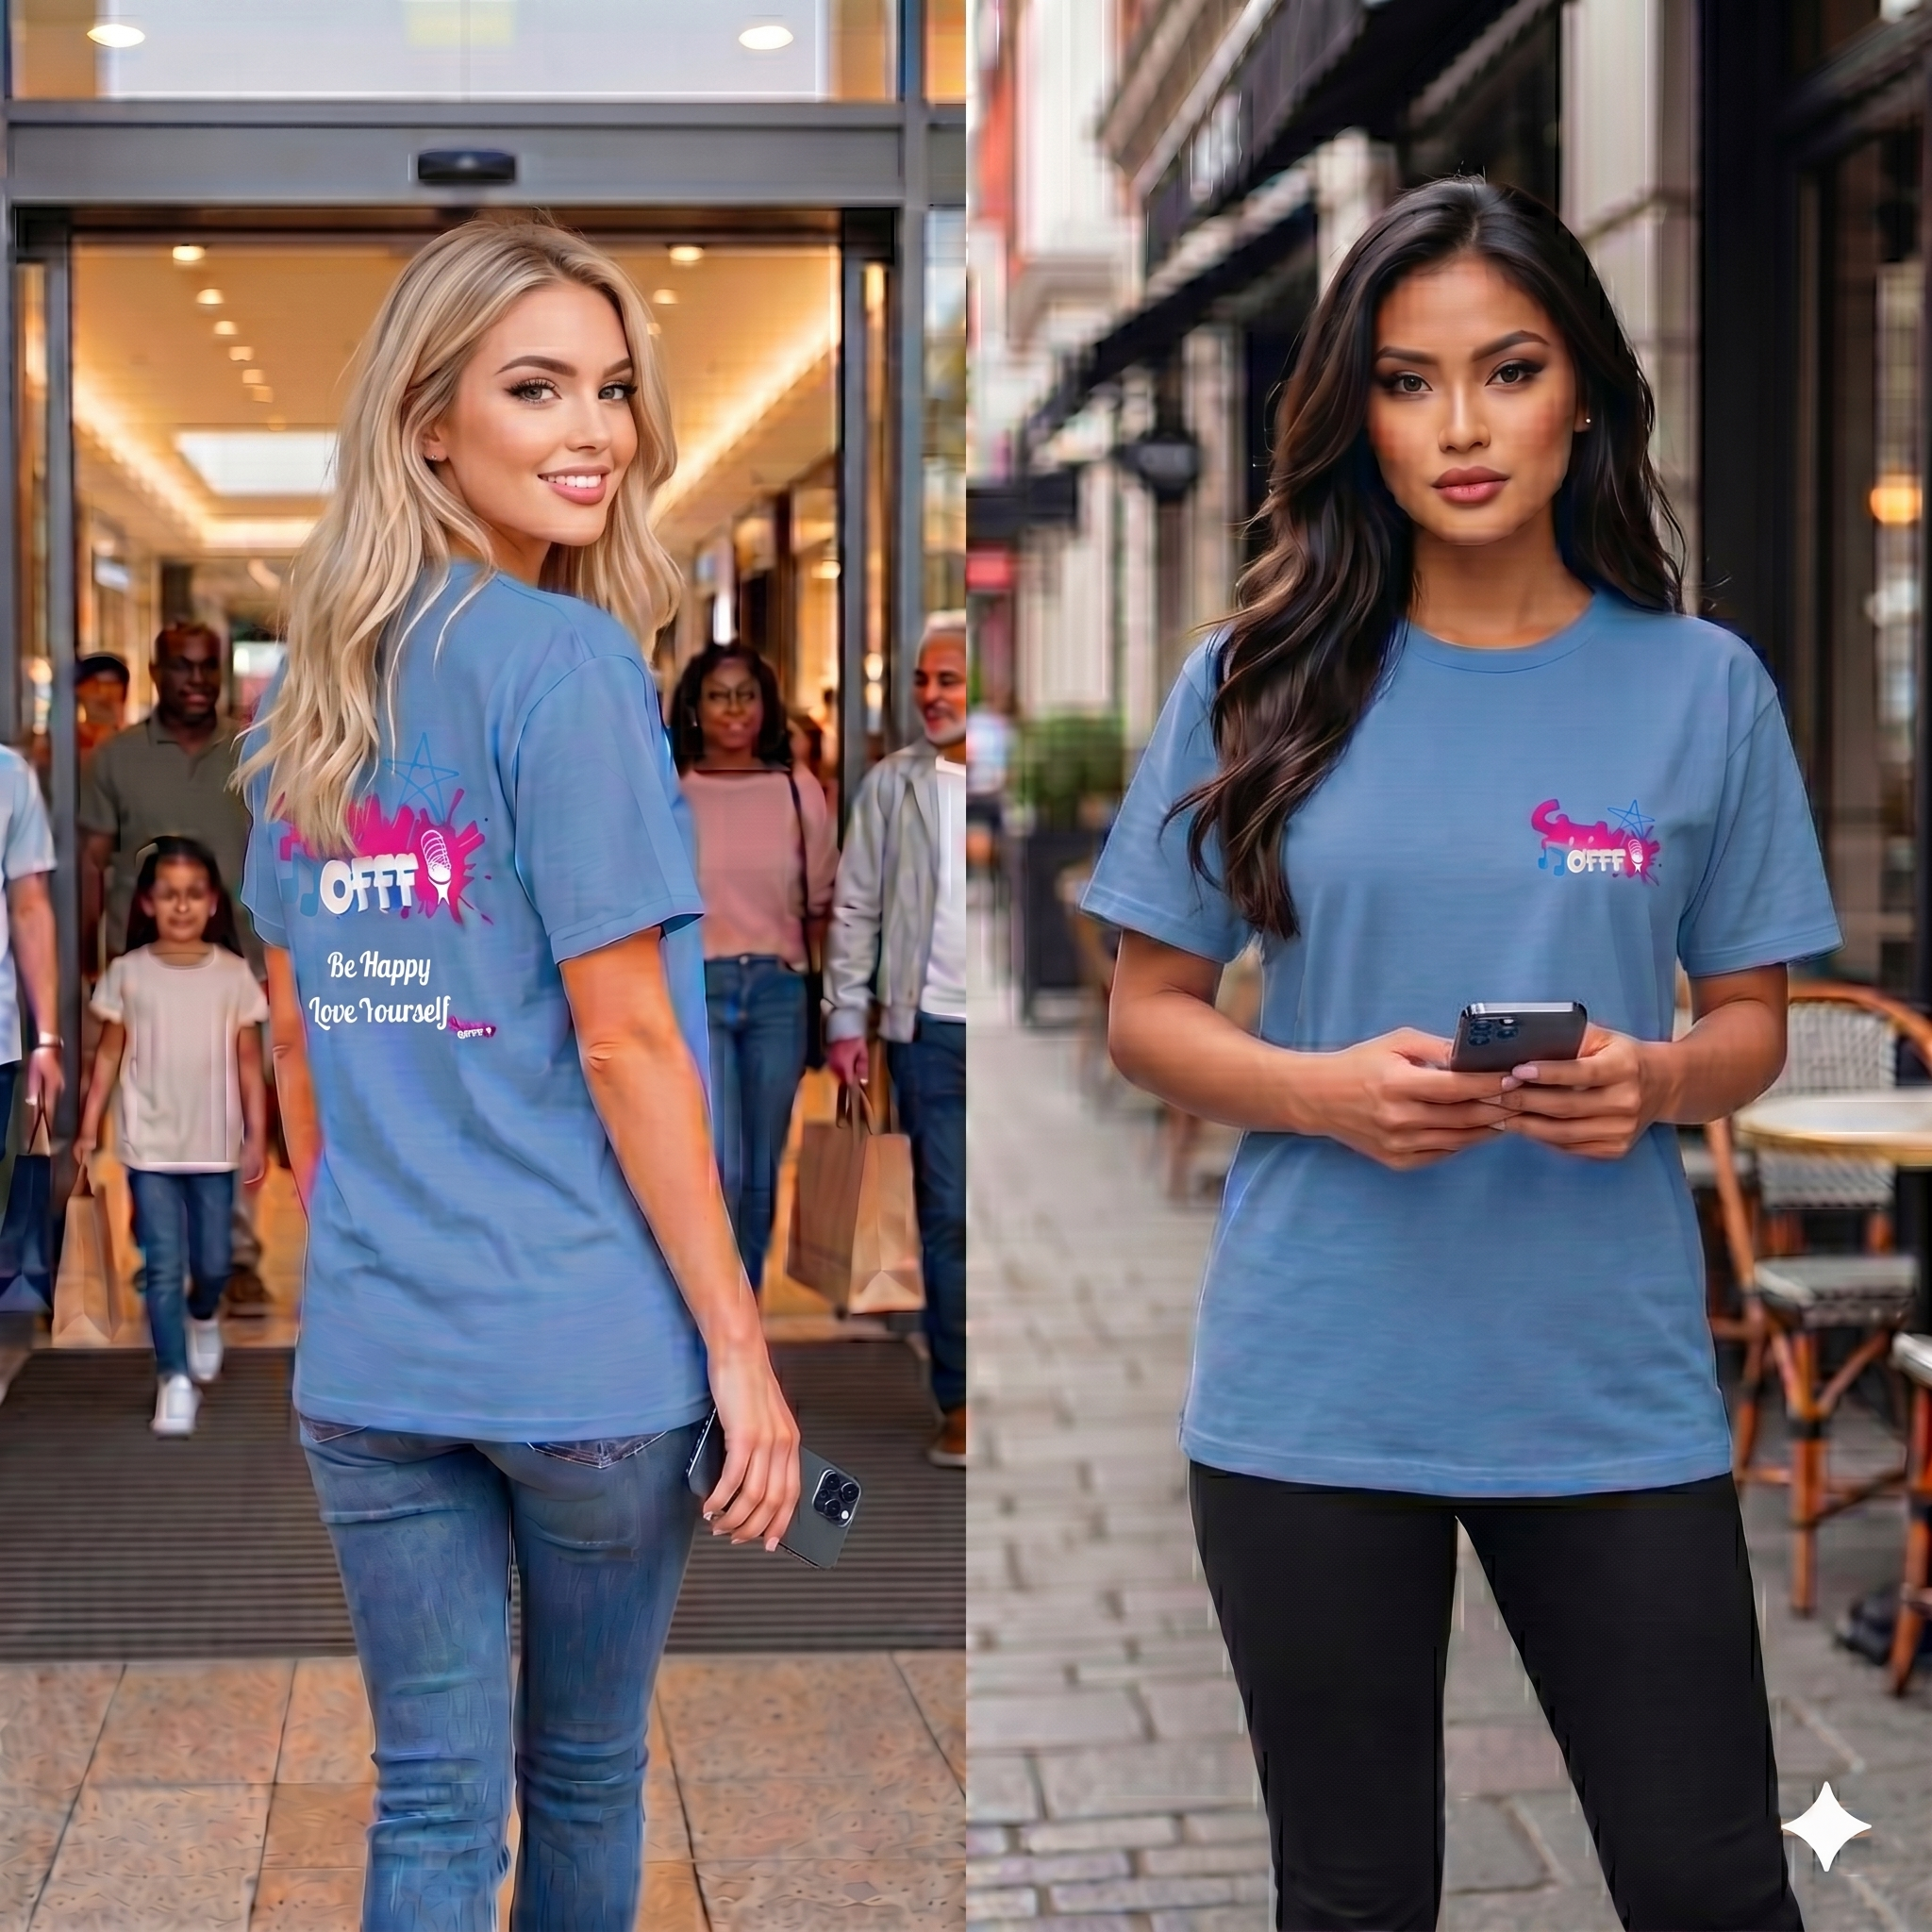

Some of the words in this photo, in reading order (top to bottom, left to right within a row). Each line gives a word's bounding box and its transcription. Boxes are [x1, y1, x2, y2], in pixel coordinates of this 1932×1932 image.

[320, 853, 419, 914] OFFF
[327, 951, 358, 978] Be
[359, 950, 431, 987] Happy
[308, 996, 358, 1031] Love
[359, 995, 452, 1031] Yourself
